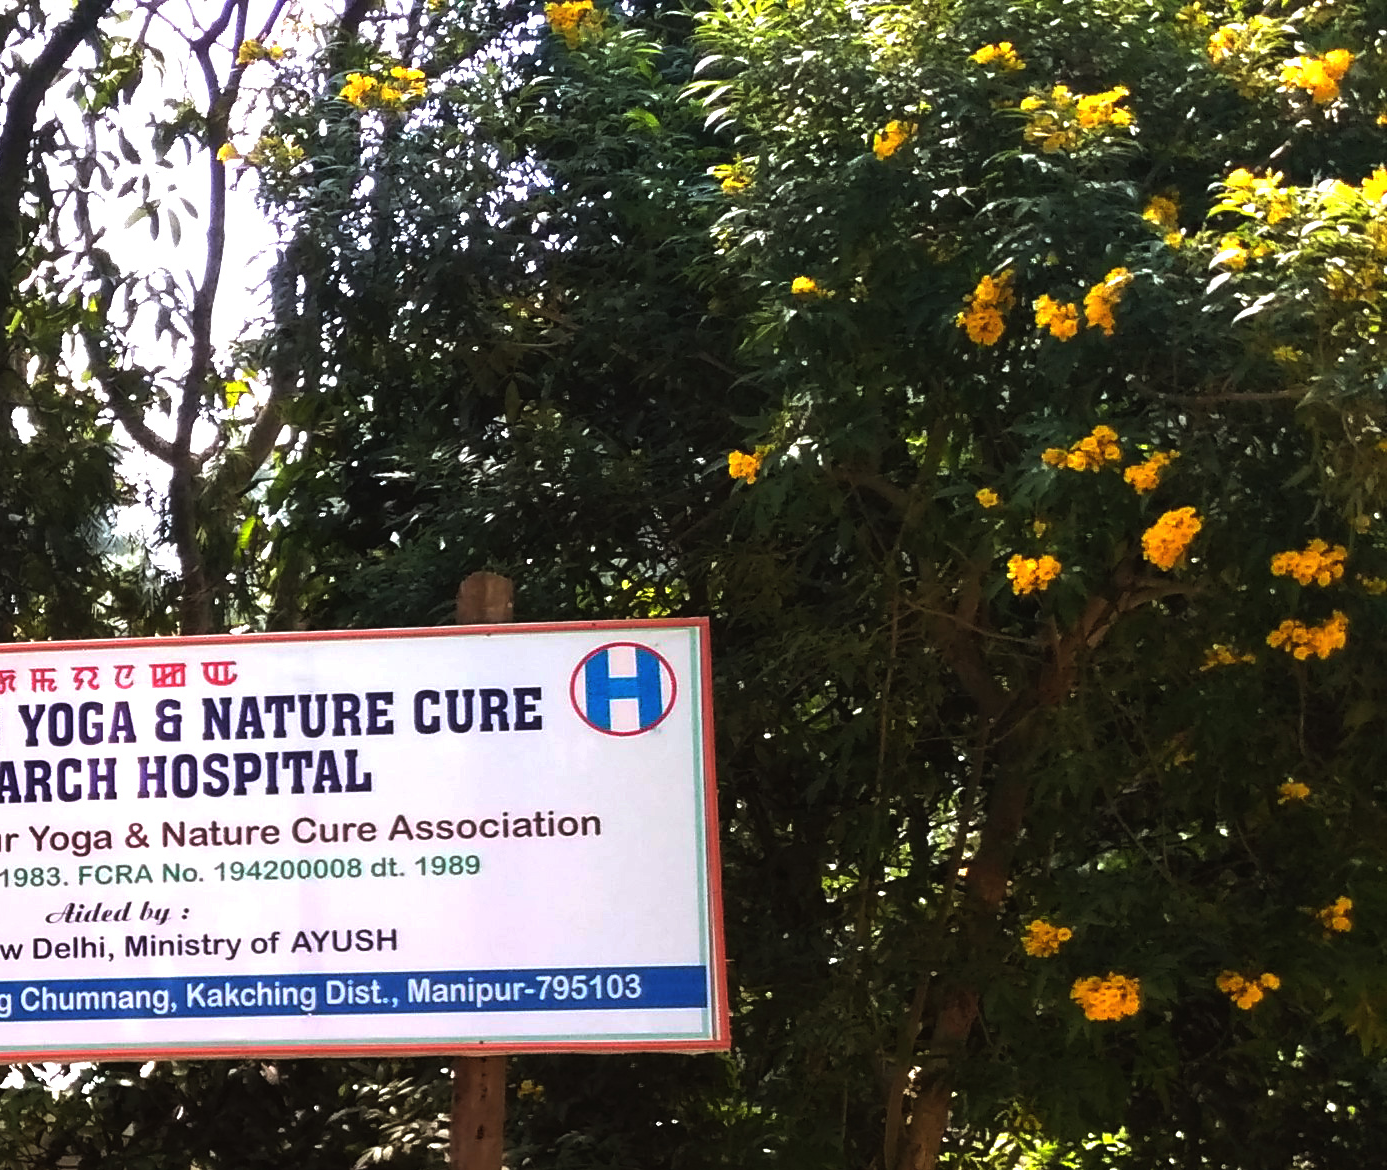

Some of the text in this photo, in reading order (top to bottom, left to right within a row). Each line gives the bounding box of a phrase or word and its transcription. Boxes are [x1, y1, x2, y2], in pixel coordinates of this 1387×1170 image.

[18, 701, 136, 747] YOGA
[155, 699, 182, 742] &
[202, 692, 394, 740] NATURE
[414, 687, 542, 734] CURE
[138, 749, 372, 798] HOSPITAL
[29, 826, 112, 857] Yoga
[125, 823, 149, 848] &
[163, 821, 279, 847] Nature
[292, 817, 376, 843] Cure
[389, 811, 601, 840] Association
[0, 867, 68, 887] 1983.
[79, 864, 153, 885] FCRA
[163, 863, 203, 882] No.
[215, 858, 361, 881] 194200008
[371, 858, 404, 877] dt.
[415, 855, 480, 875] 1989
[46, 902, 131, 923] Aided
[140, 901, 169, 925] by
[33, 936, 114, 961] Delhi,
[126, 930, 241, 960] Ministry
[251, 932, 280, 954] of
[291, 929, 397, 953] AYUSH
[19, 985, 178, 1014] Chumnang,
[186, 982, 317, 1012] Kakching
[326, 979, 398, 1007] Dist.,
[408, 974, 642, 1007] Manipur-795103
